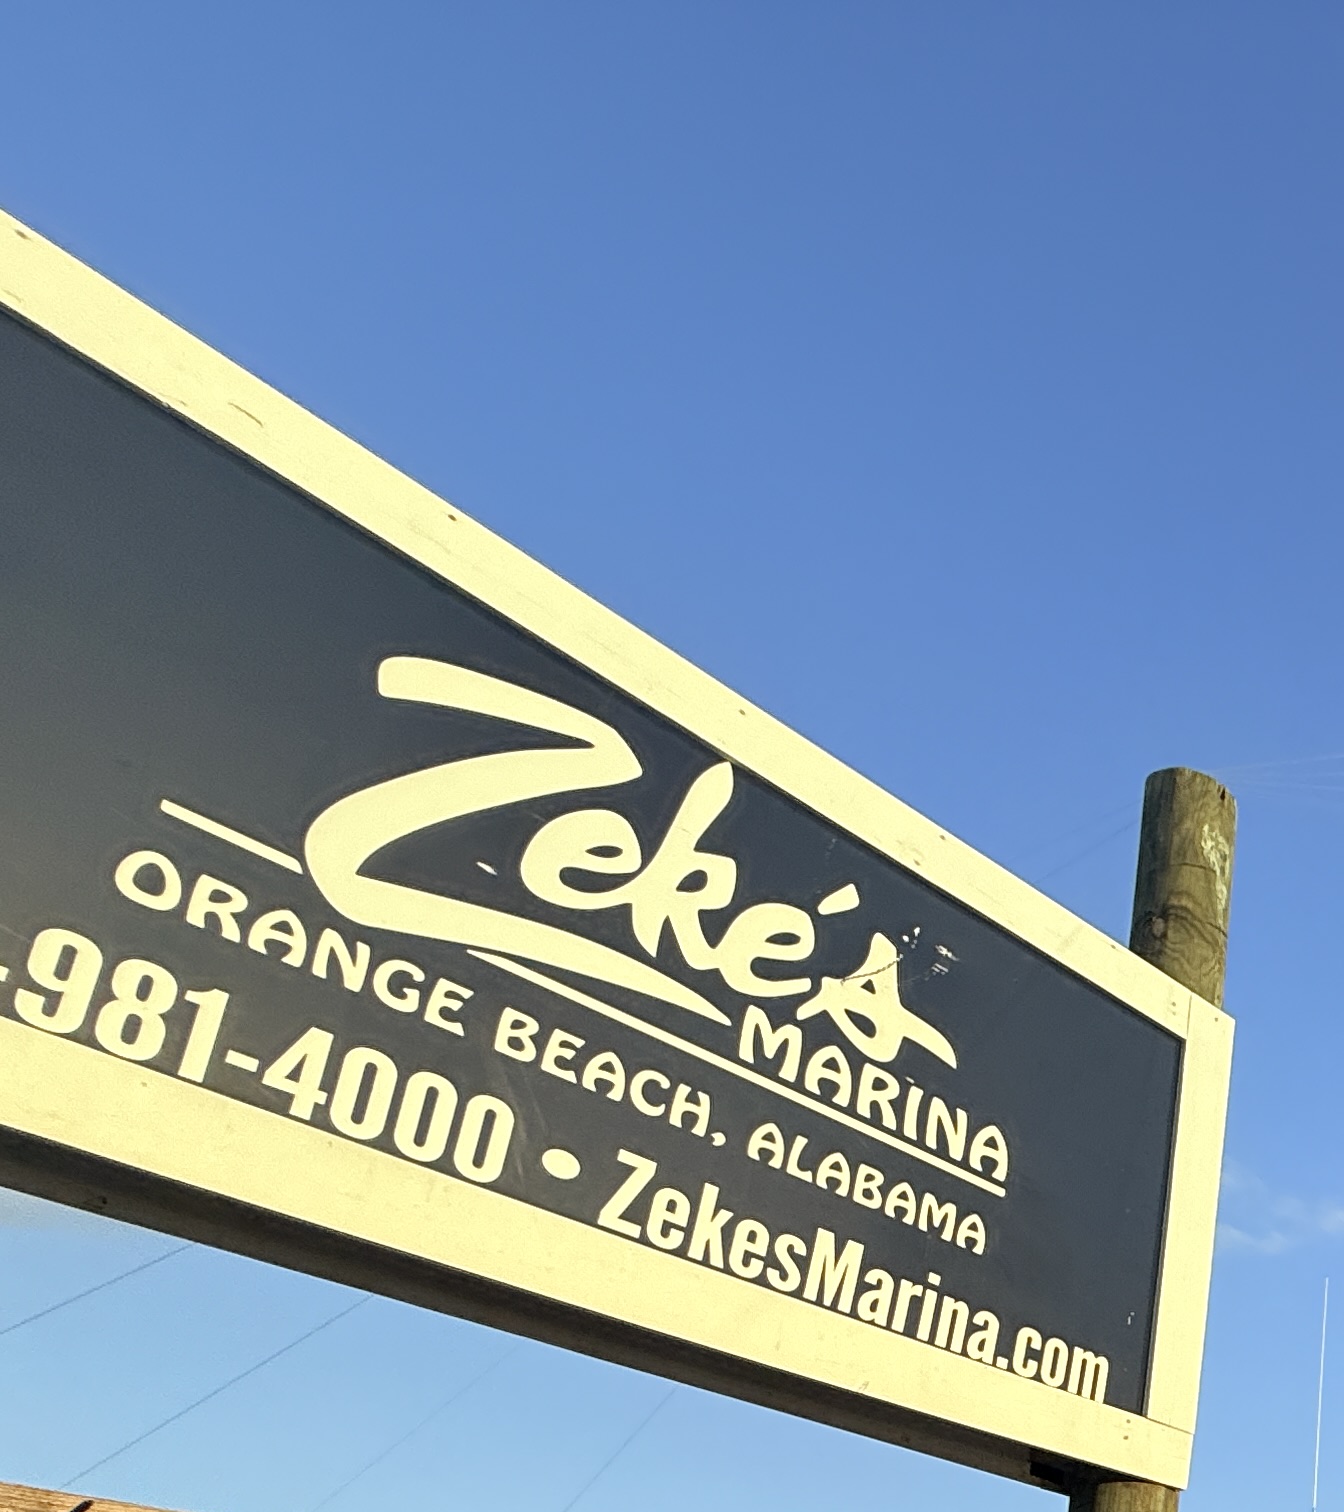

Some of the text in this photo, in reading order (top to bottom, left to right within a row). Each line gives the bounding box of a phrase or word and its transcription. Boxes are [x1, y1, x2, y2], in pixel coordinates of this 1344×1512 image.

[115, 851, 986, 1256] ORANGE BEACH, ALABAMA
[305, 657, 957, 1069] Zeke's
[0, 929, 1109, 1404] 981-4000 ZekesMarina.com
[739, 1005, 1008, 1181] MARINA
